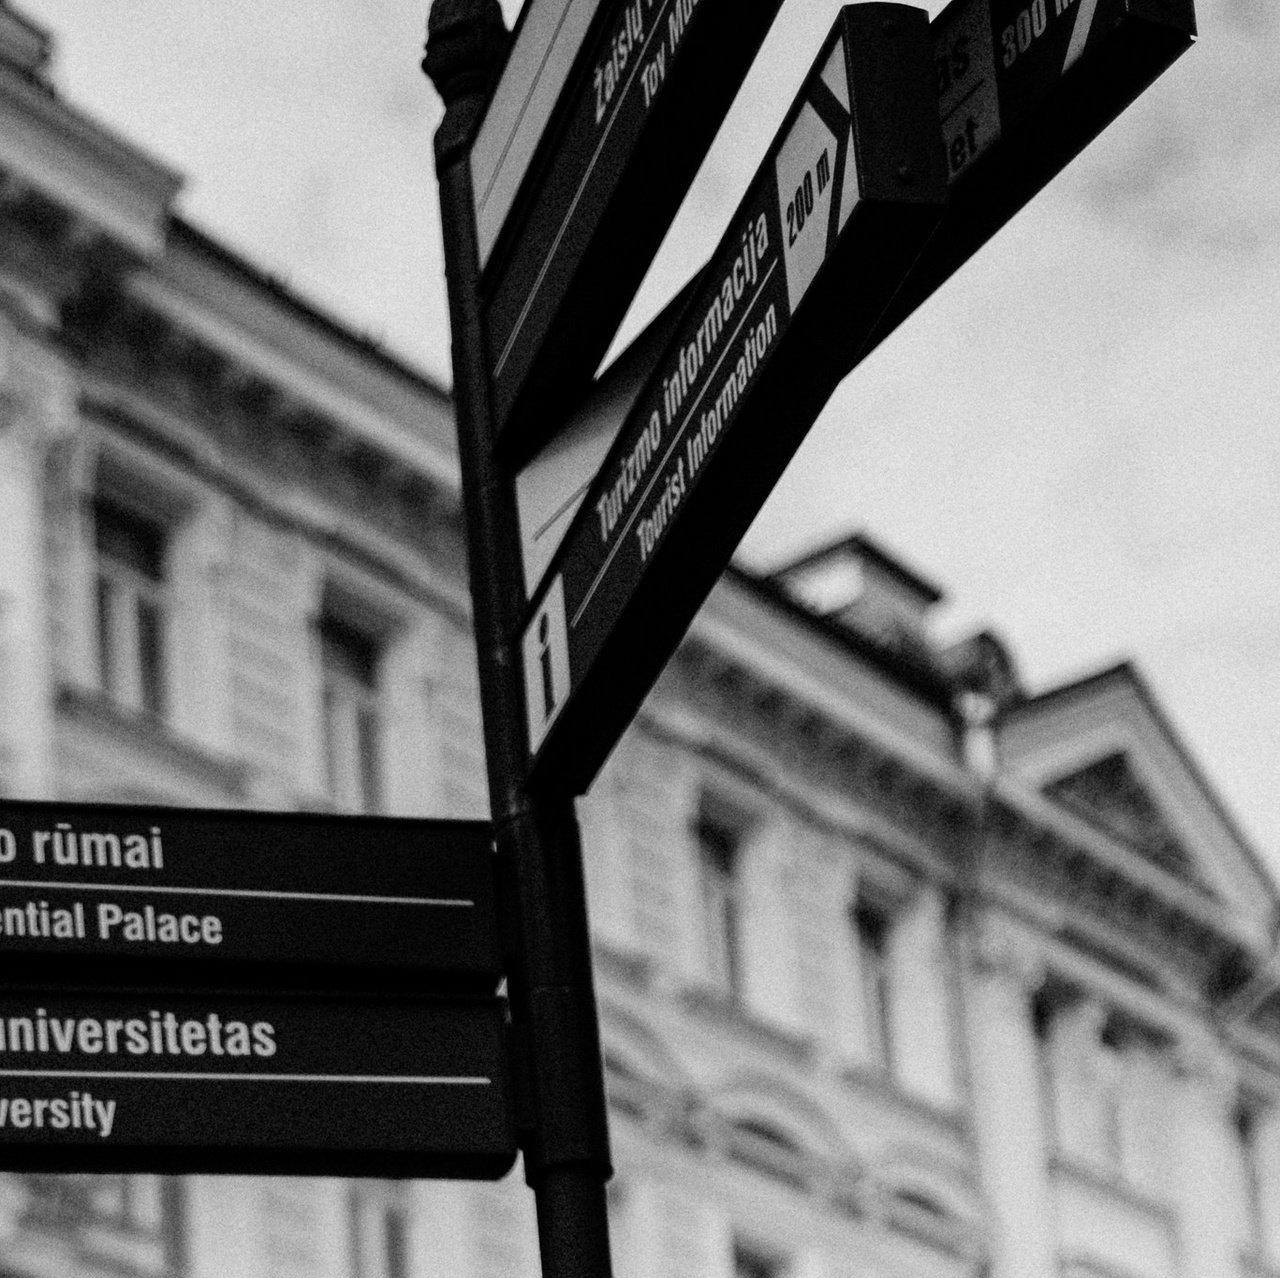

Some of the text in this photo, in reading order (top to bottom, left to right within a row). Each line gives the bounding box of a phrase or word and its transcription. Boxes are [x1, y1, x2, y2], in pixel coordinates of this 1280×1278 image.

[1002, 0, 1047, 69] 300
[641, 41, 667, 109] Toy
[786, 147, 830, 249] 200 m
[596, 212, 769, 543] Turizmo informacija
[636, 303, 777, 562] Tourist Information
[32, 823, 164, 869] rūmai
[97, 903, 223, 945] Palace
